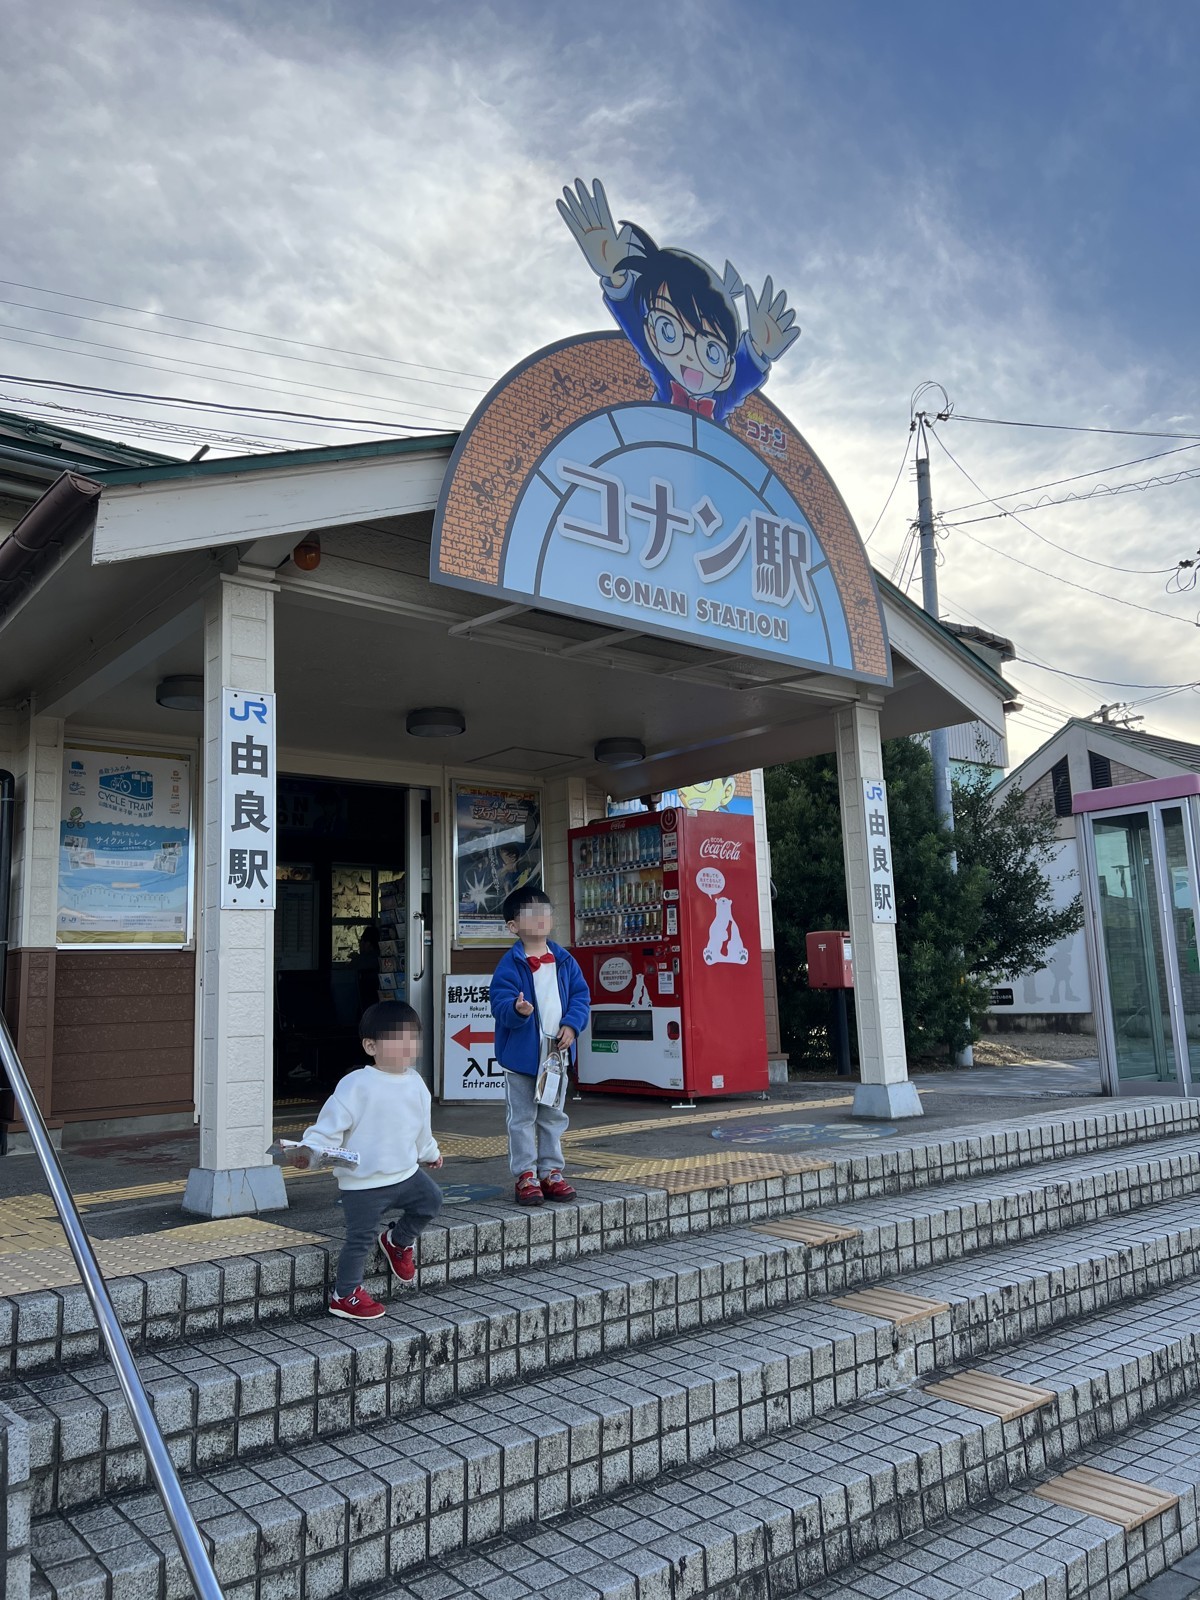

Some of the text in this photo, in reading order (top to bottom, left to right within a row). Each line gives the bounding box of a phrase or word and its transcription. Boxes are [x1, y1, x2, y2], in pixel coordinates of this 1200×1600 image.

[746, 419, 787, 450] コナン
[559, 460, 813, 611] コナン駅
[598, 572, 789, 642] CONAN STATION
[229, 701, 268, 724] JR
[98, 790, 126, 807] CYCLE
[128, 800, 154, 811] TRAIN
[866, 786, 883, 801] JR
[227, 734, 271, 890] 由良駅
[94, 835, 157, 847] サイクル トレイン
[700, 839, 742, 860] Coca-Cola
[868, 808, 892, 911] 由良駅
[462, 1057, 505, 1078] 入口
[462, 1079, 505, 1088] Entrance
[348, 1296, 360, 1306] N
